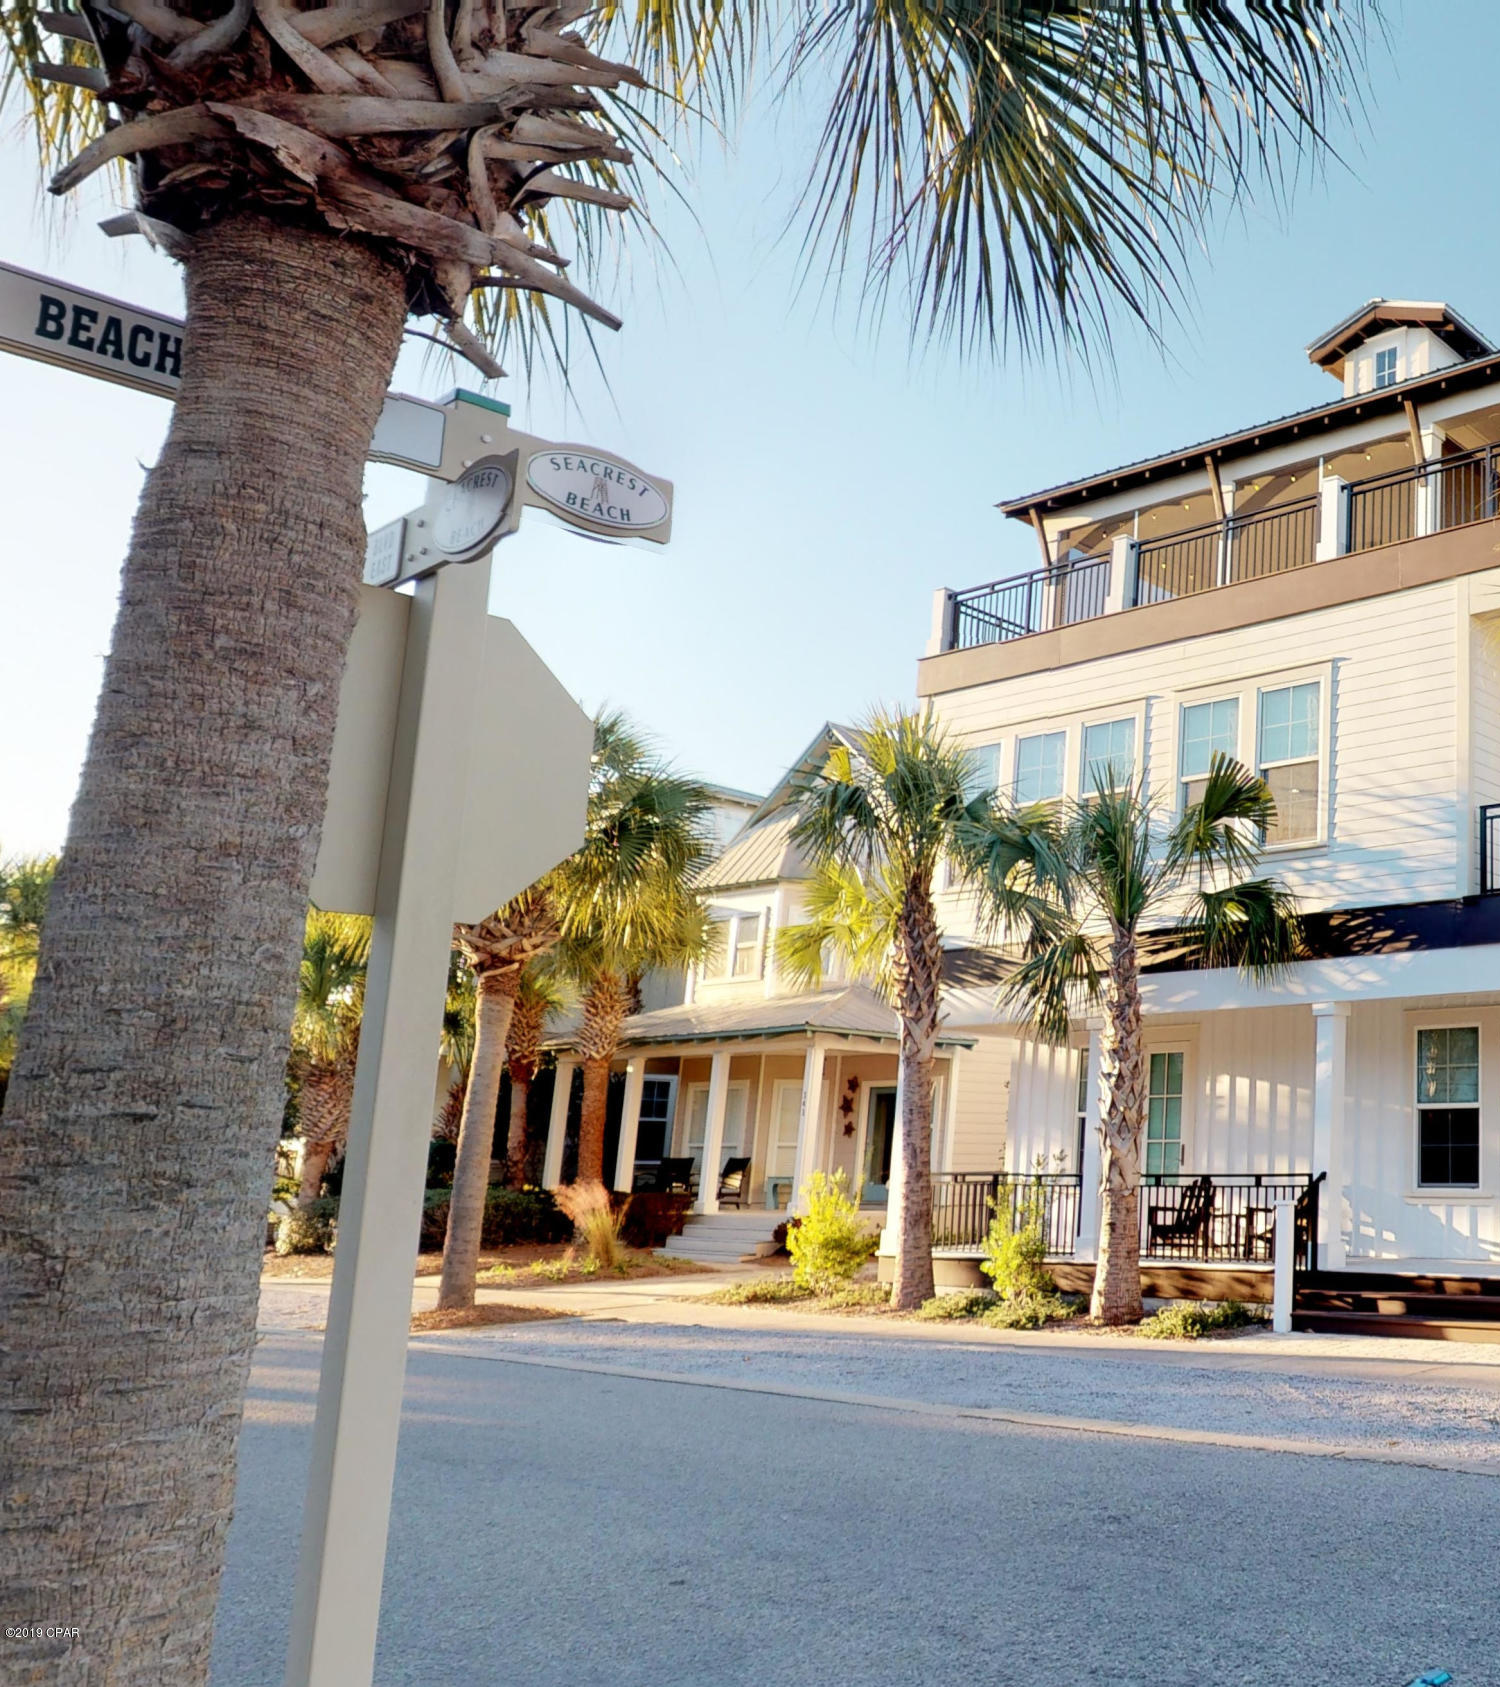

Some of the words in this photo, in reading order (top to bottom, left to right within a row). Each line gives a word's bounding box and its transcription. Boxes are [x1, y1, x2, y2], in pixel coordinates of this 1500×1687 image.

[35, 294, 183, 378] BEACH
[550, 456, 649, 497] SEACREST
[566, 491, 631, 522] BEACH
